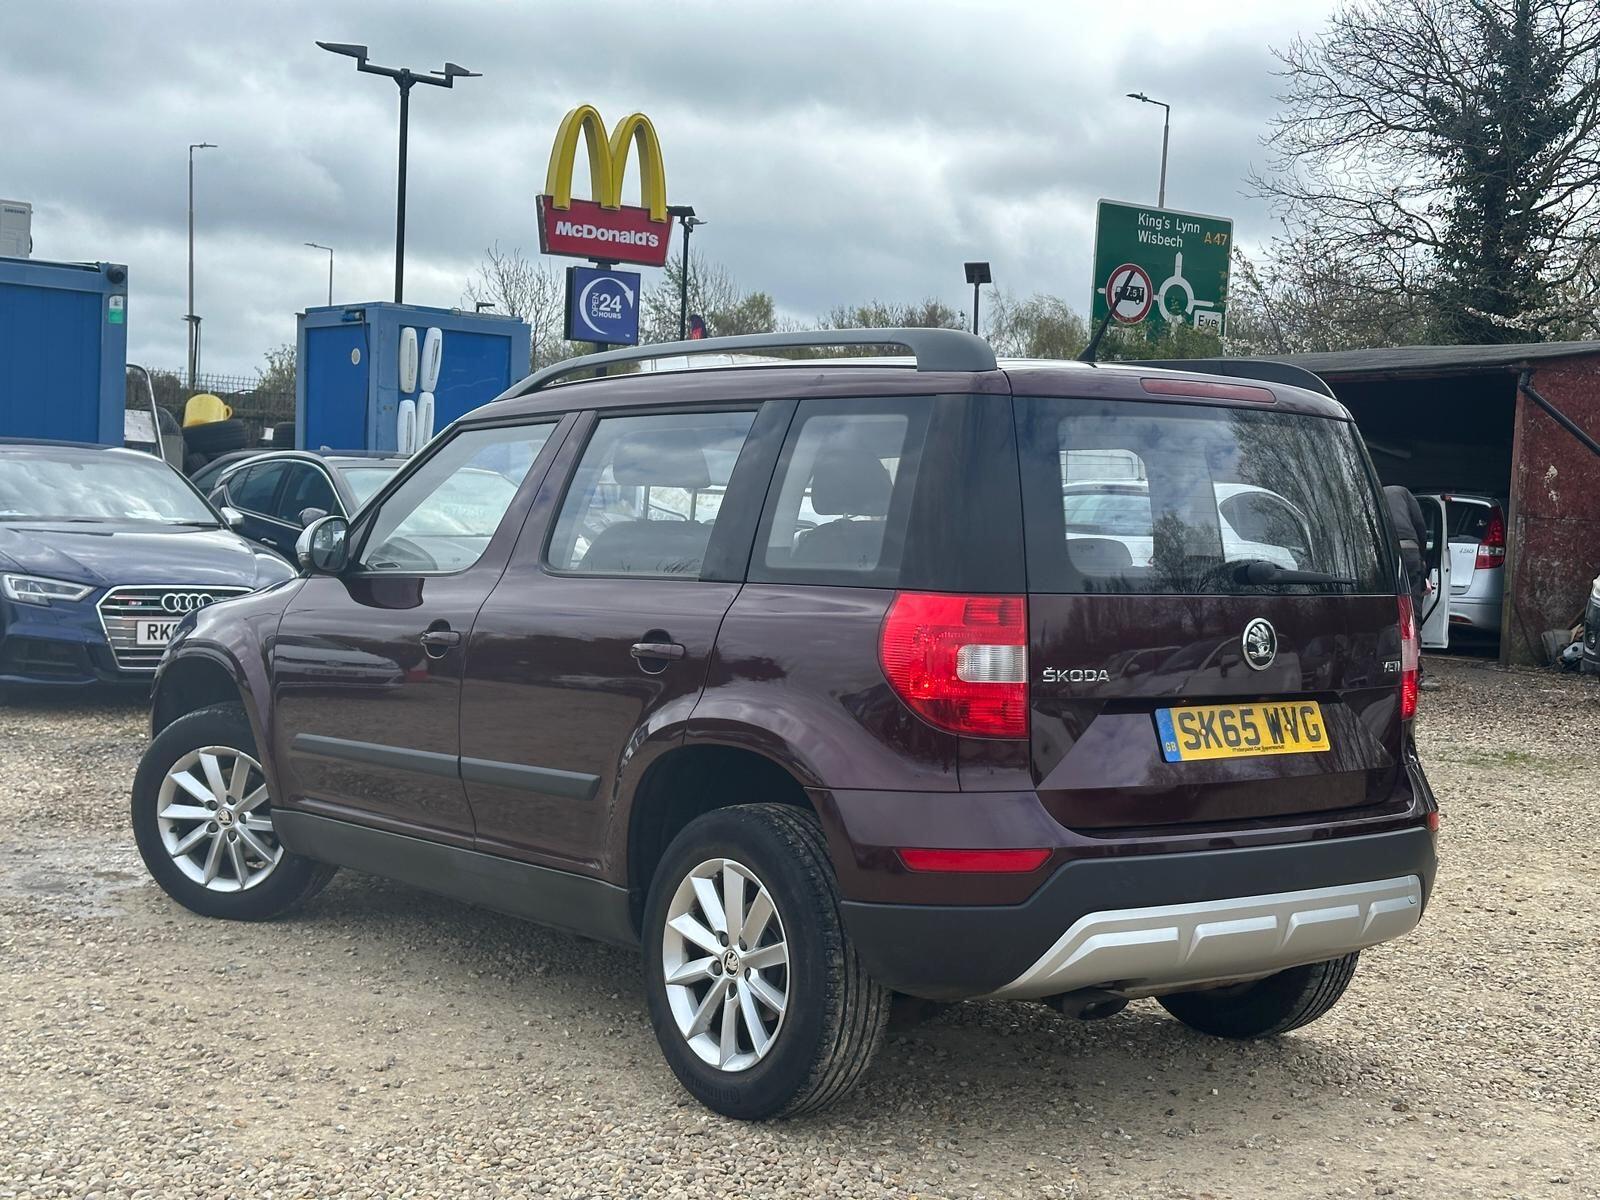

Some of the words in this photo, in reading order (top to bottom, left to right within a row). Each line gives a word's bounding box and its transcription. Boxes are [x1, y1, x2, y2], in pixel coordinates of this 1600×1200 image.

[1138, 213, 1171, 231] King's
[1176, 218, 1201, 234] Lynn
[555, 221, 660, 248] McDonald's
[1137, 229, 1183, 248] Wisbech
[1204, 231, 1228, 246] A47
[591, 292, 600, 317] OPEN
[599, 293, 622, 312] 24
[598, 311, 622, 320] HOURS
[147, 623, 178, 641] RK
[1042, 666, 1111, 683] ŠKODA
[1177, 708, 1262, 751] SK65
[1263, 705, 1322, 744] WVG
[1165, 741, 1177, 753] GB
